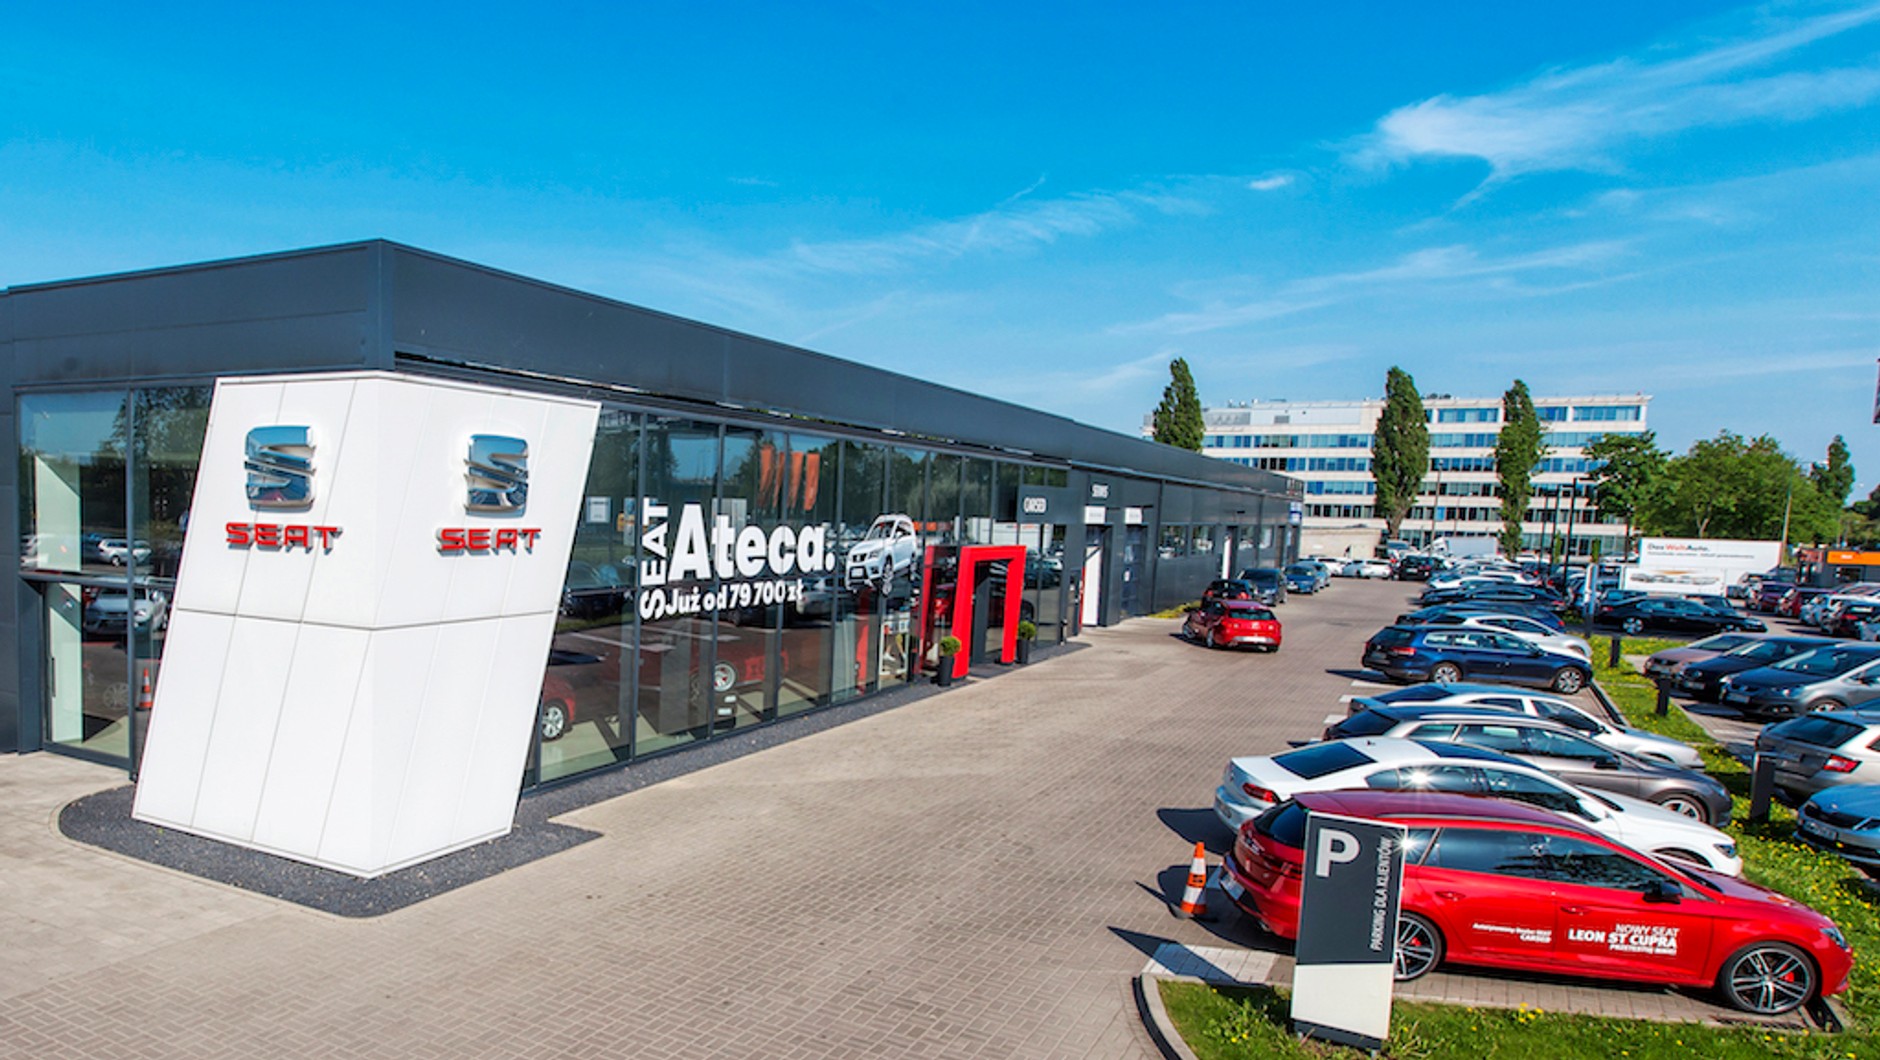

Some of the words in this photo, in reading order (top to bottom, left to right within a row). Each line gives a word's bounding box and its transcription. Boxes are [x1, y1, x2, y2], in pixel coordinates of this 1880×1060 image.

[225, 522, 343, 554] SEAT
[436, 528, 542, 556] SEAT
[667, 503, 835, 579] Ateca.
[639, 497, 669, 620] SEAT
[665, 586, 701, 615] Już
[702, 584, 727, 611] od
[728, 582, 751, 609] 79
[752, 580, 786, 606] 700
[1315, 827, 1361, 878] P
[1376, 836, 1393, 887] KLIENTÓW
[1374, 887, 1388, 908] DLA
[1370, 909, 1386, 951] PARKING
[1568, 928, 1606, 944] LEON
[1607, 931, 1628, 945] ST
[1629, 934, 1678, 950] CUPRA
[1615, 923, 1652, 935] NOWY
[1652, 926, 1680, 937] SEAT
